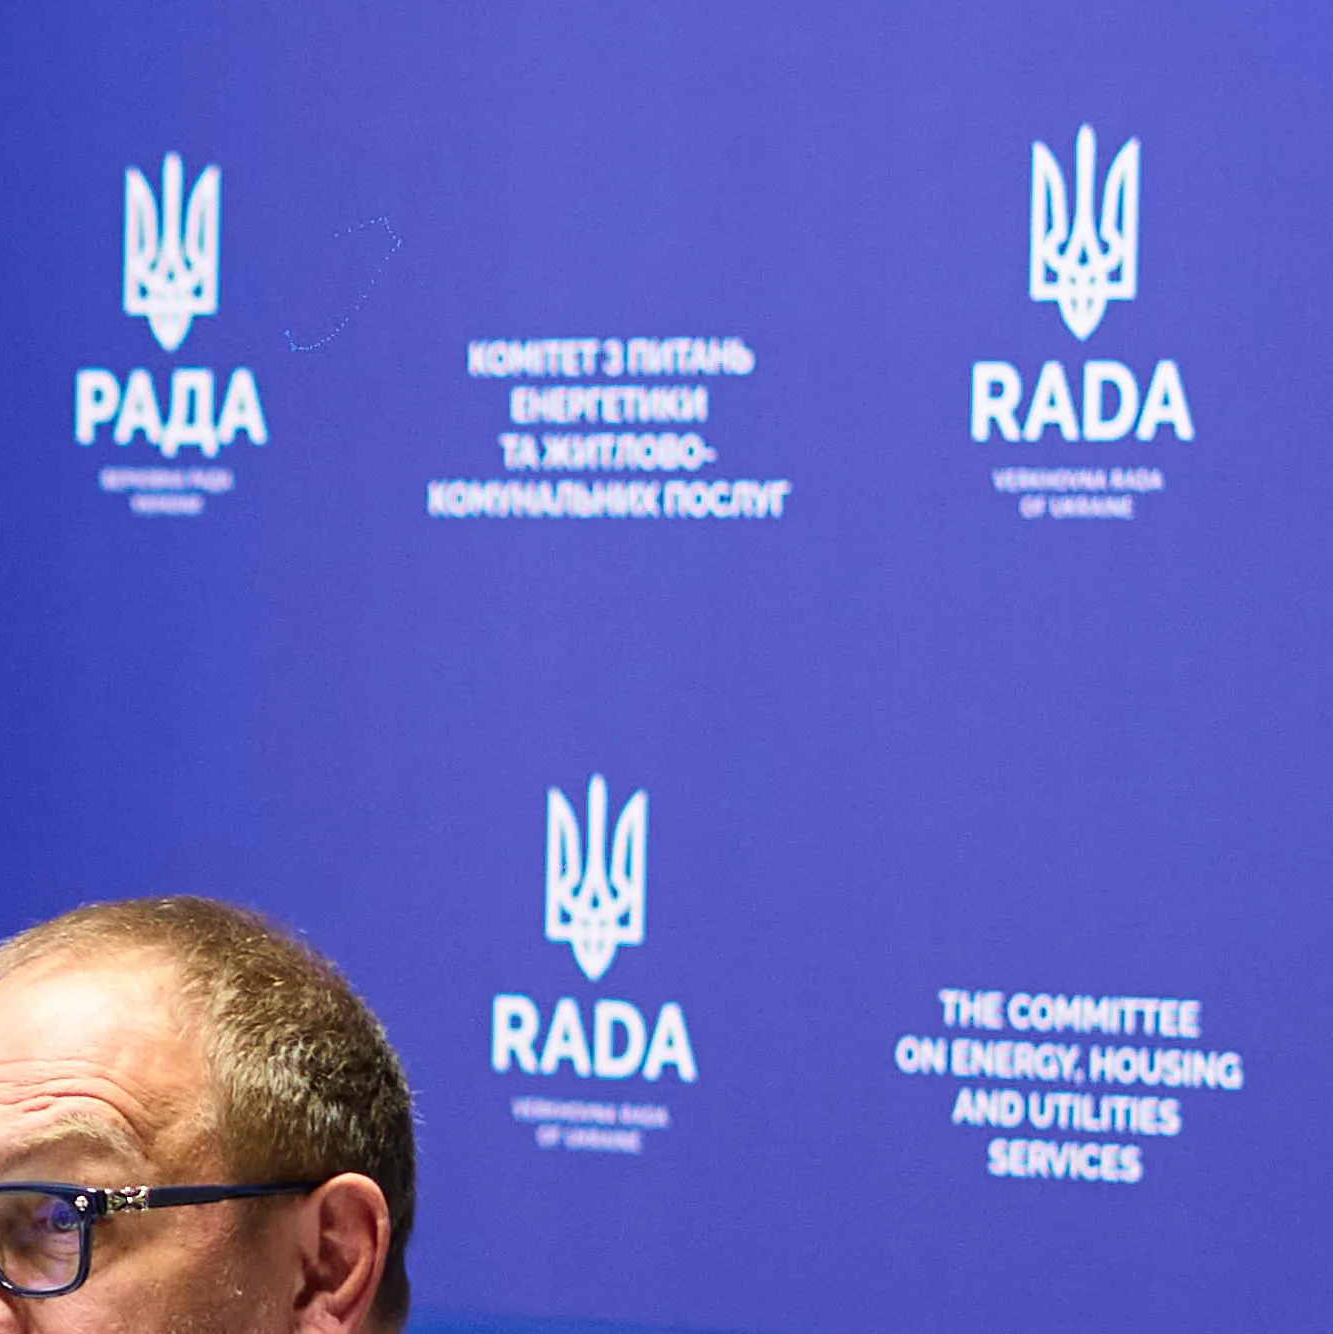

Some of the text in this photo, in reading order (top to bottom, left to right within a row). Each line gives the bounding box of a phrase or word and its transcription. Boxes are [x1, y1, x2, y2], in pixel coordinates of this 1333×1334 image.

[468, 338, 754, 376] КОМІТЕТ З ПИТАНЬ
[76, 368, 267, 457] РАДА
[511, 386, 708, 423] ЕНЕРГЕТИКИ
[971, 360, 1194, 441] RADA
[499, 433, 717, 470] ТА ЖИТЛОВО-
[428, 480, 791, 518] КОМУНАЛЬНИХ ПОСЛУГ
[938, 989, 1200, 1038] THE COMMITTEE
[492, 995, 697, 1081] RADA
[895, 1036, 1243, 1089] ON ENERGY, HOUSING
[952, 1088, 1182, 1136] AND UTILITIES
[988, 1138, 1143, 1183] SERVICES
